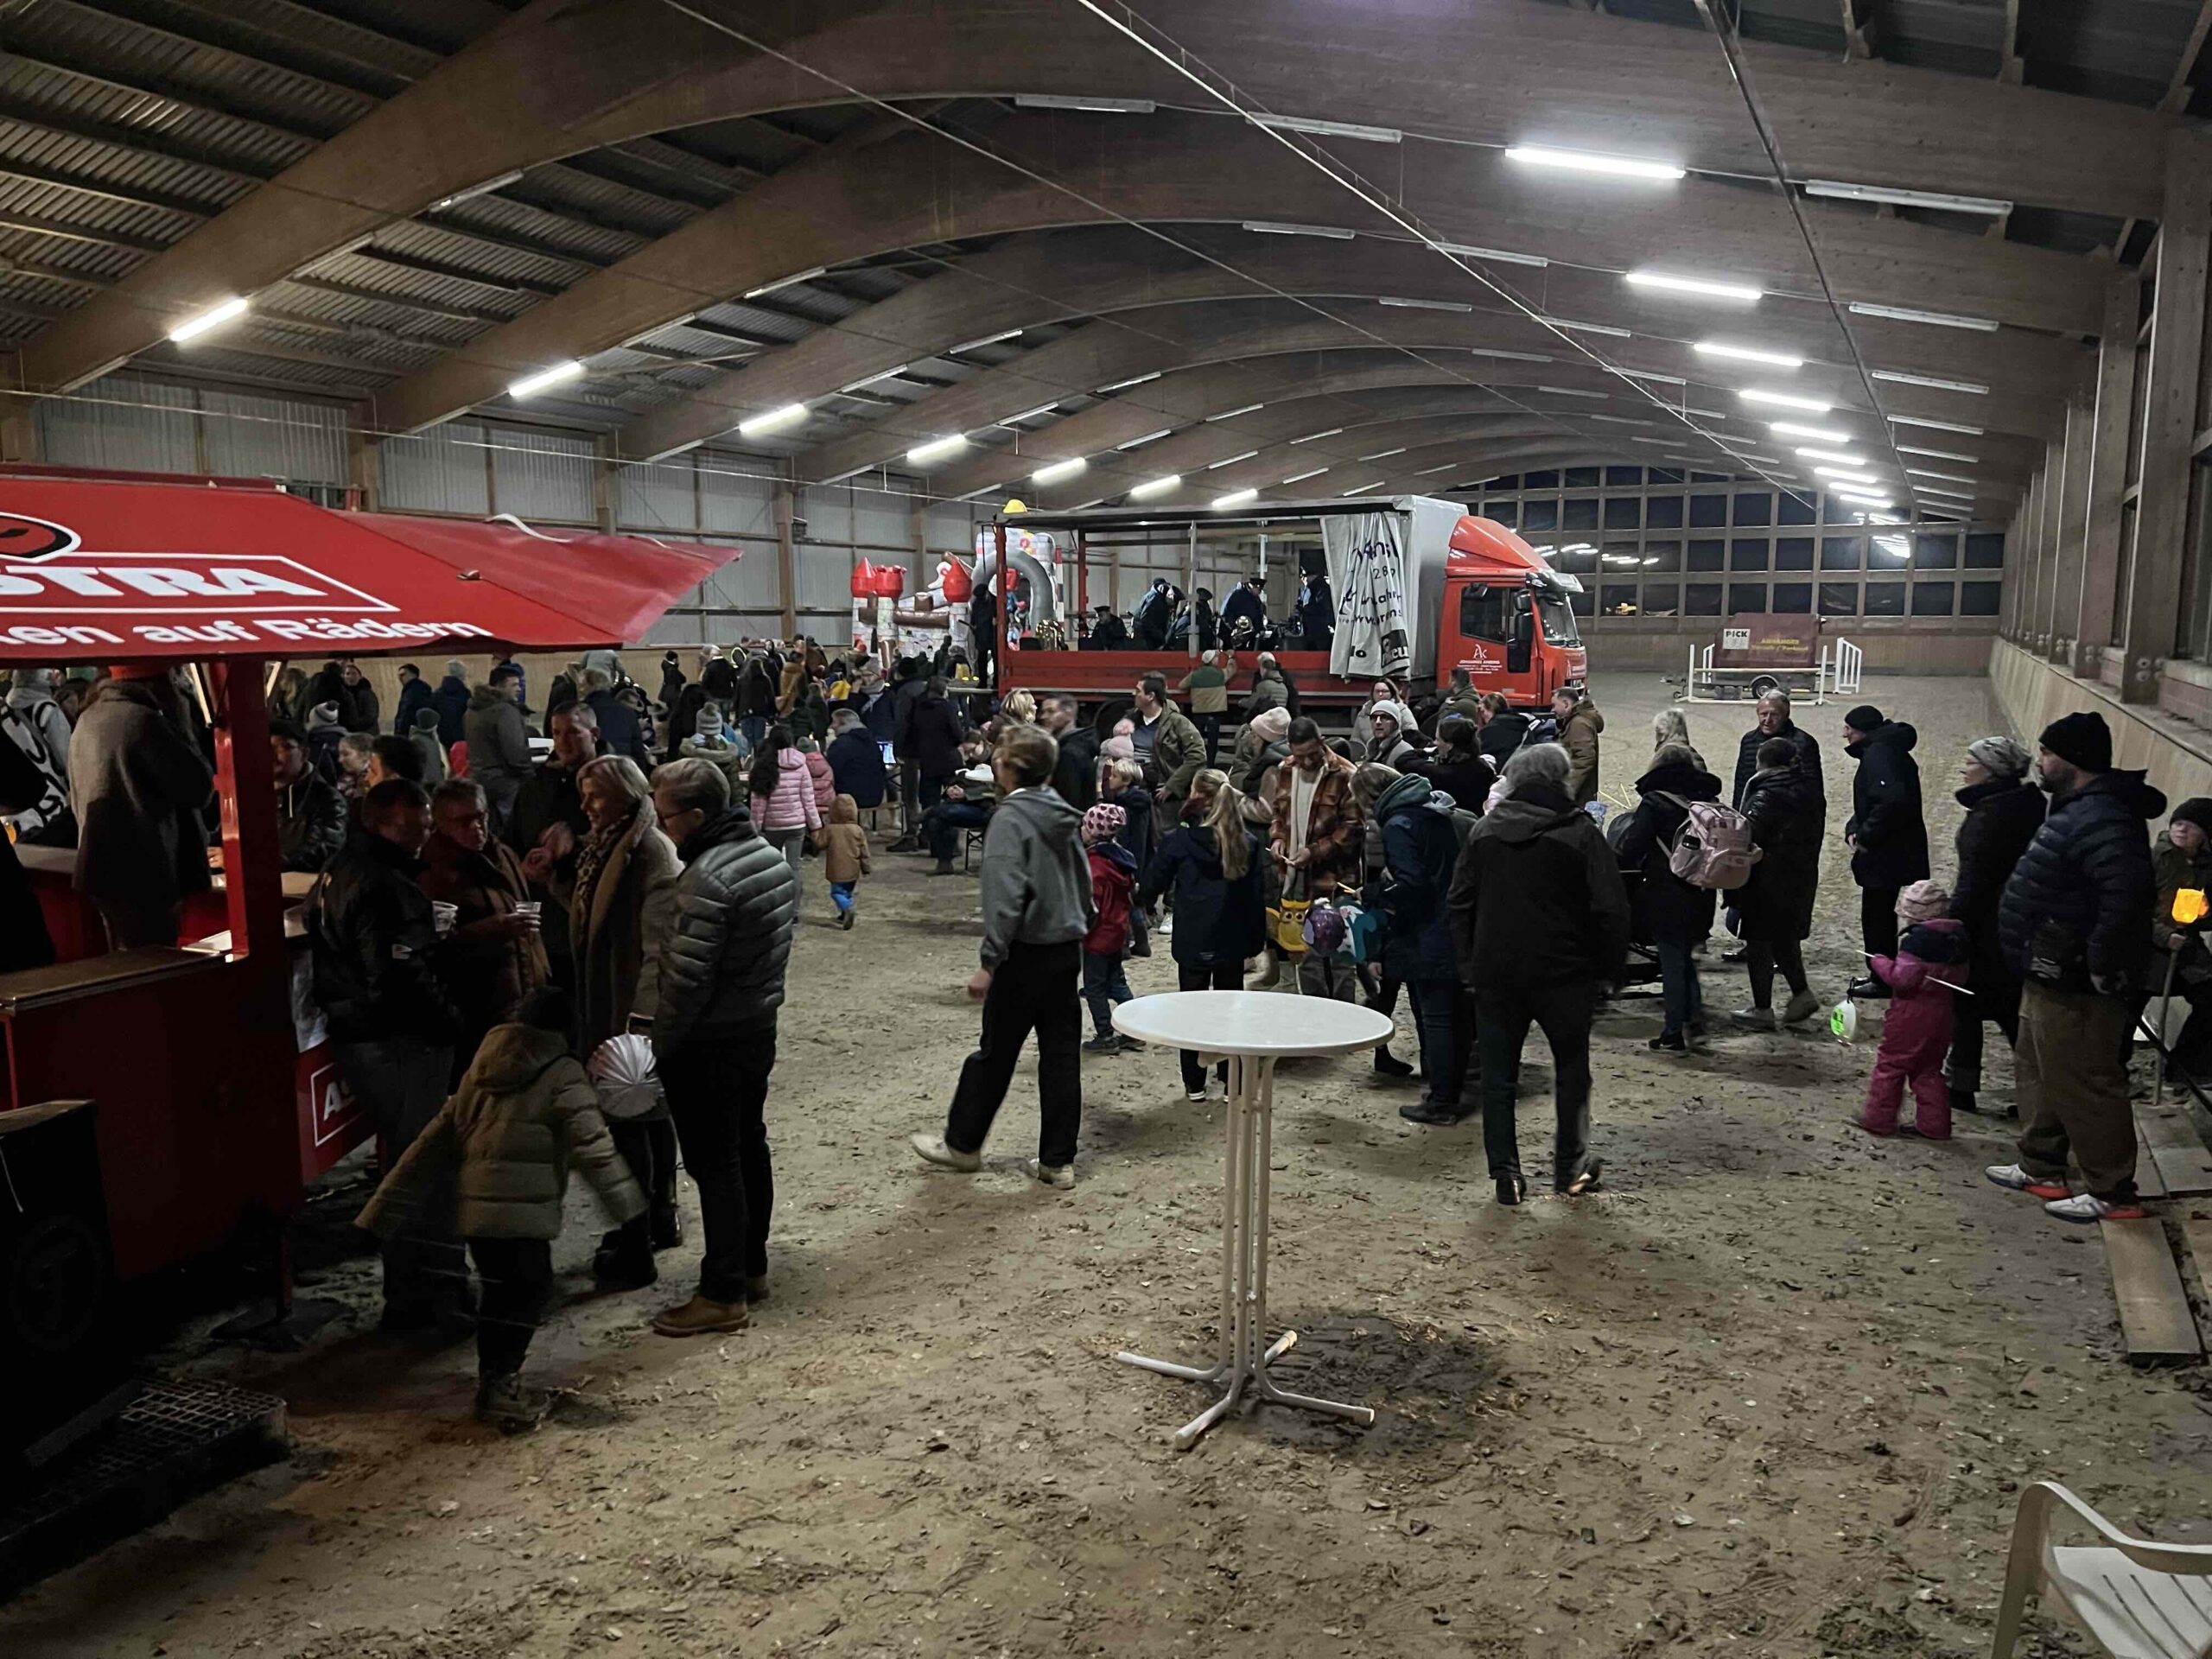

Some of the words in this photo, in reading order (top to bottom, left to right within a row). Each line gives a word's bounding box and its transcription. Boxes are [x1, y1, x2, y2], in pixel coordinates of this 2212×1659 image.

[0, 626, 125, 645] en
[132, 620, 261, 642] auf
[252, 618, 494, 640] Rädern
